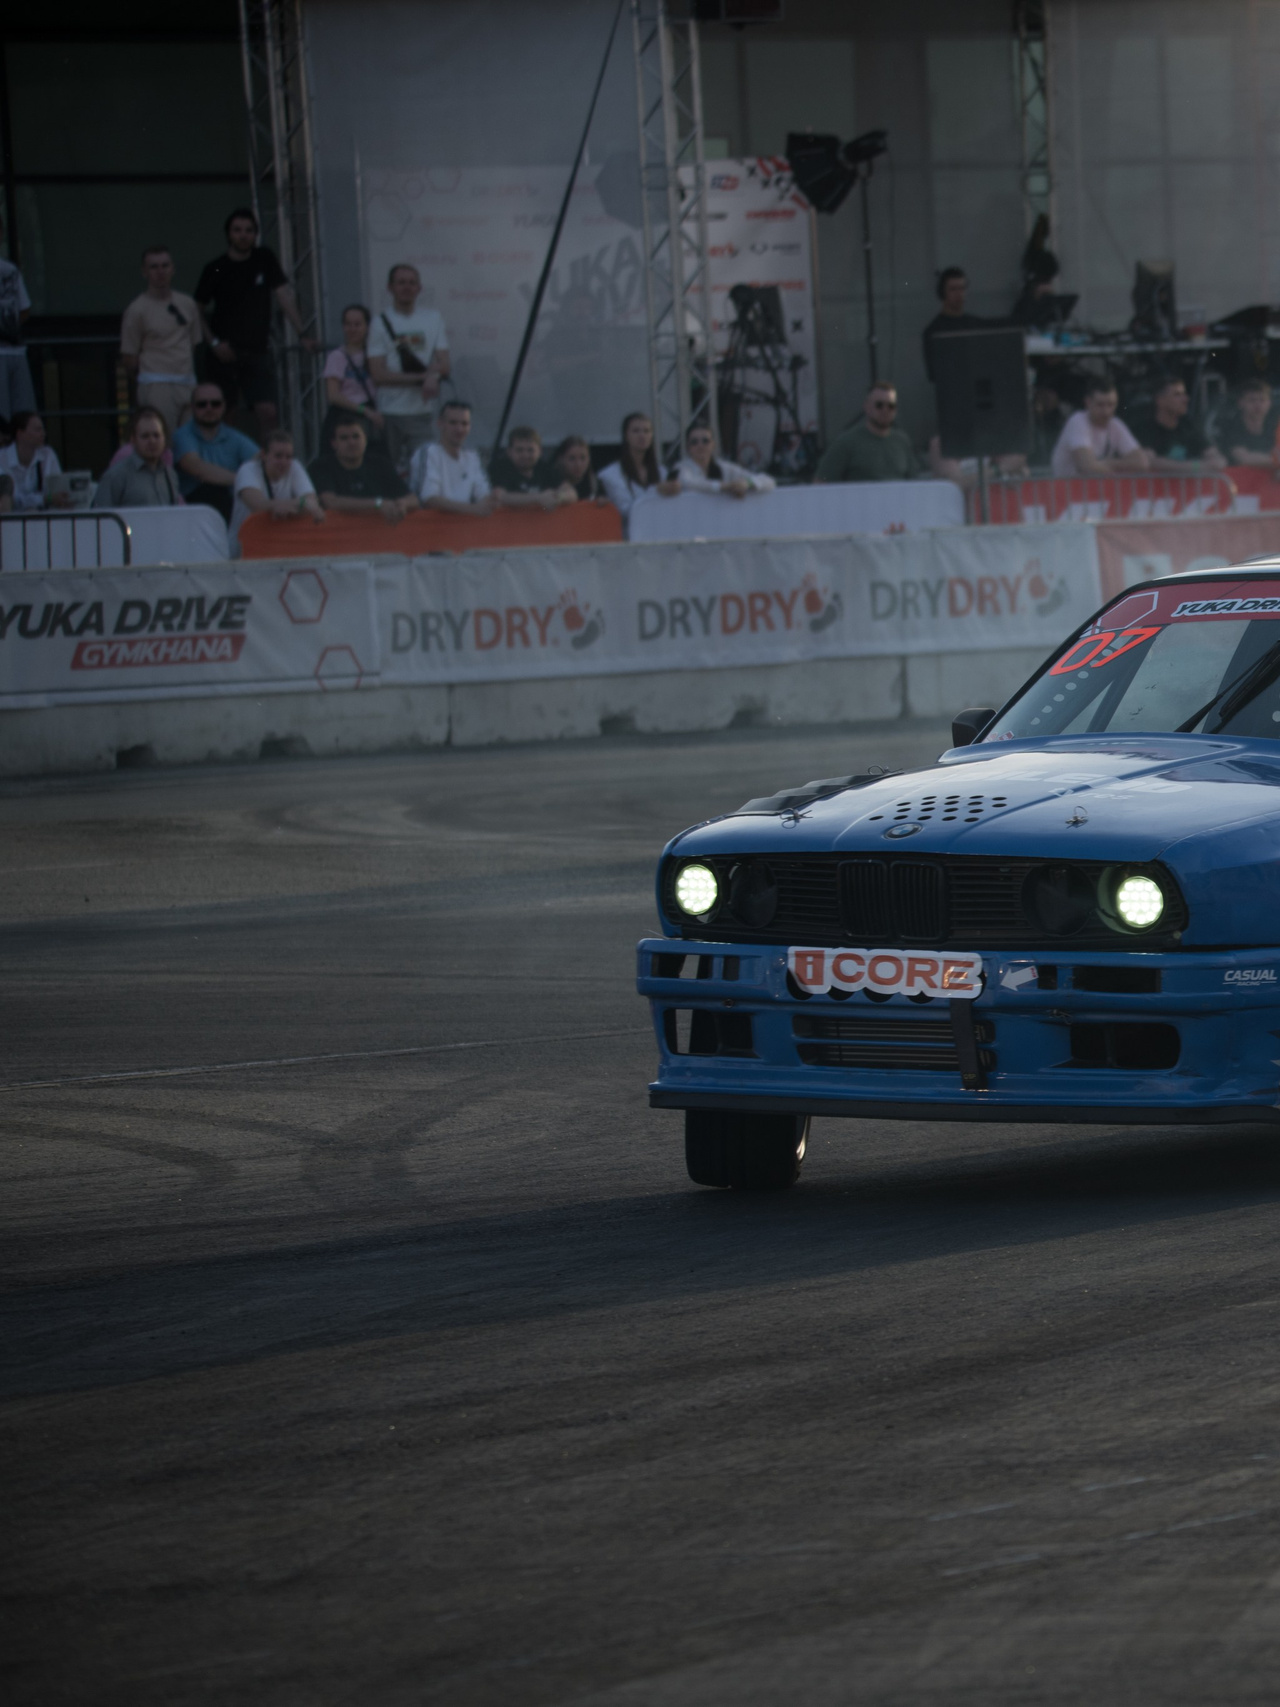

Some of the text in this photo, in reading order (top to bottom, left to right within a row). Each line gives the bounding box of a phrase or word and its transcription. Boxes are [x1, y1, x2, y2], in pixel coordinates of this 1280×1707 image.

[112, 595, 253, 636] DRIVE
[637, 586, 800, 642] DRYDRY
[870, 573, 1025, 621] DRYDRY
[1178, 600, 1236, 615] YUKA
[391, 604, 550, 653] DRYDRY
[79, 637, 235, 668] GYMKHANA
[1048, 626, 1163, 676] 07
[1224, 969, 1278, 981] CASUAL
